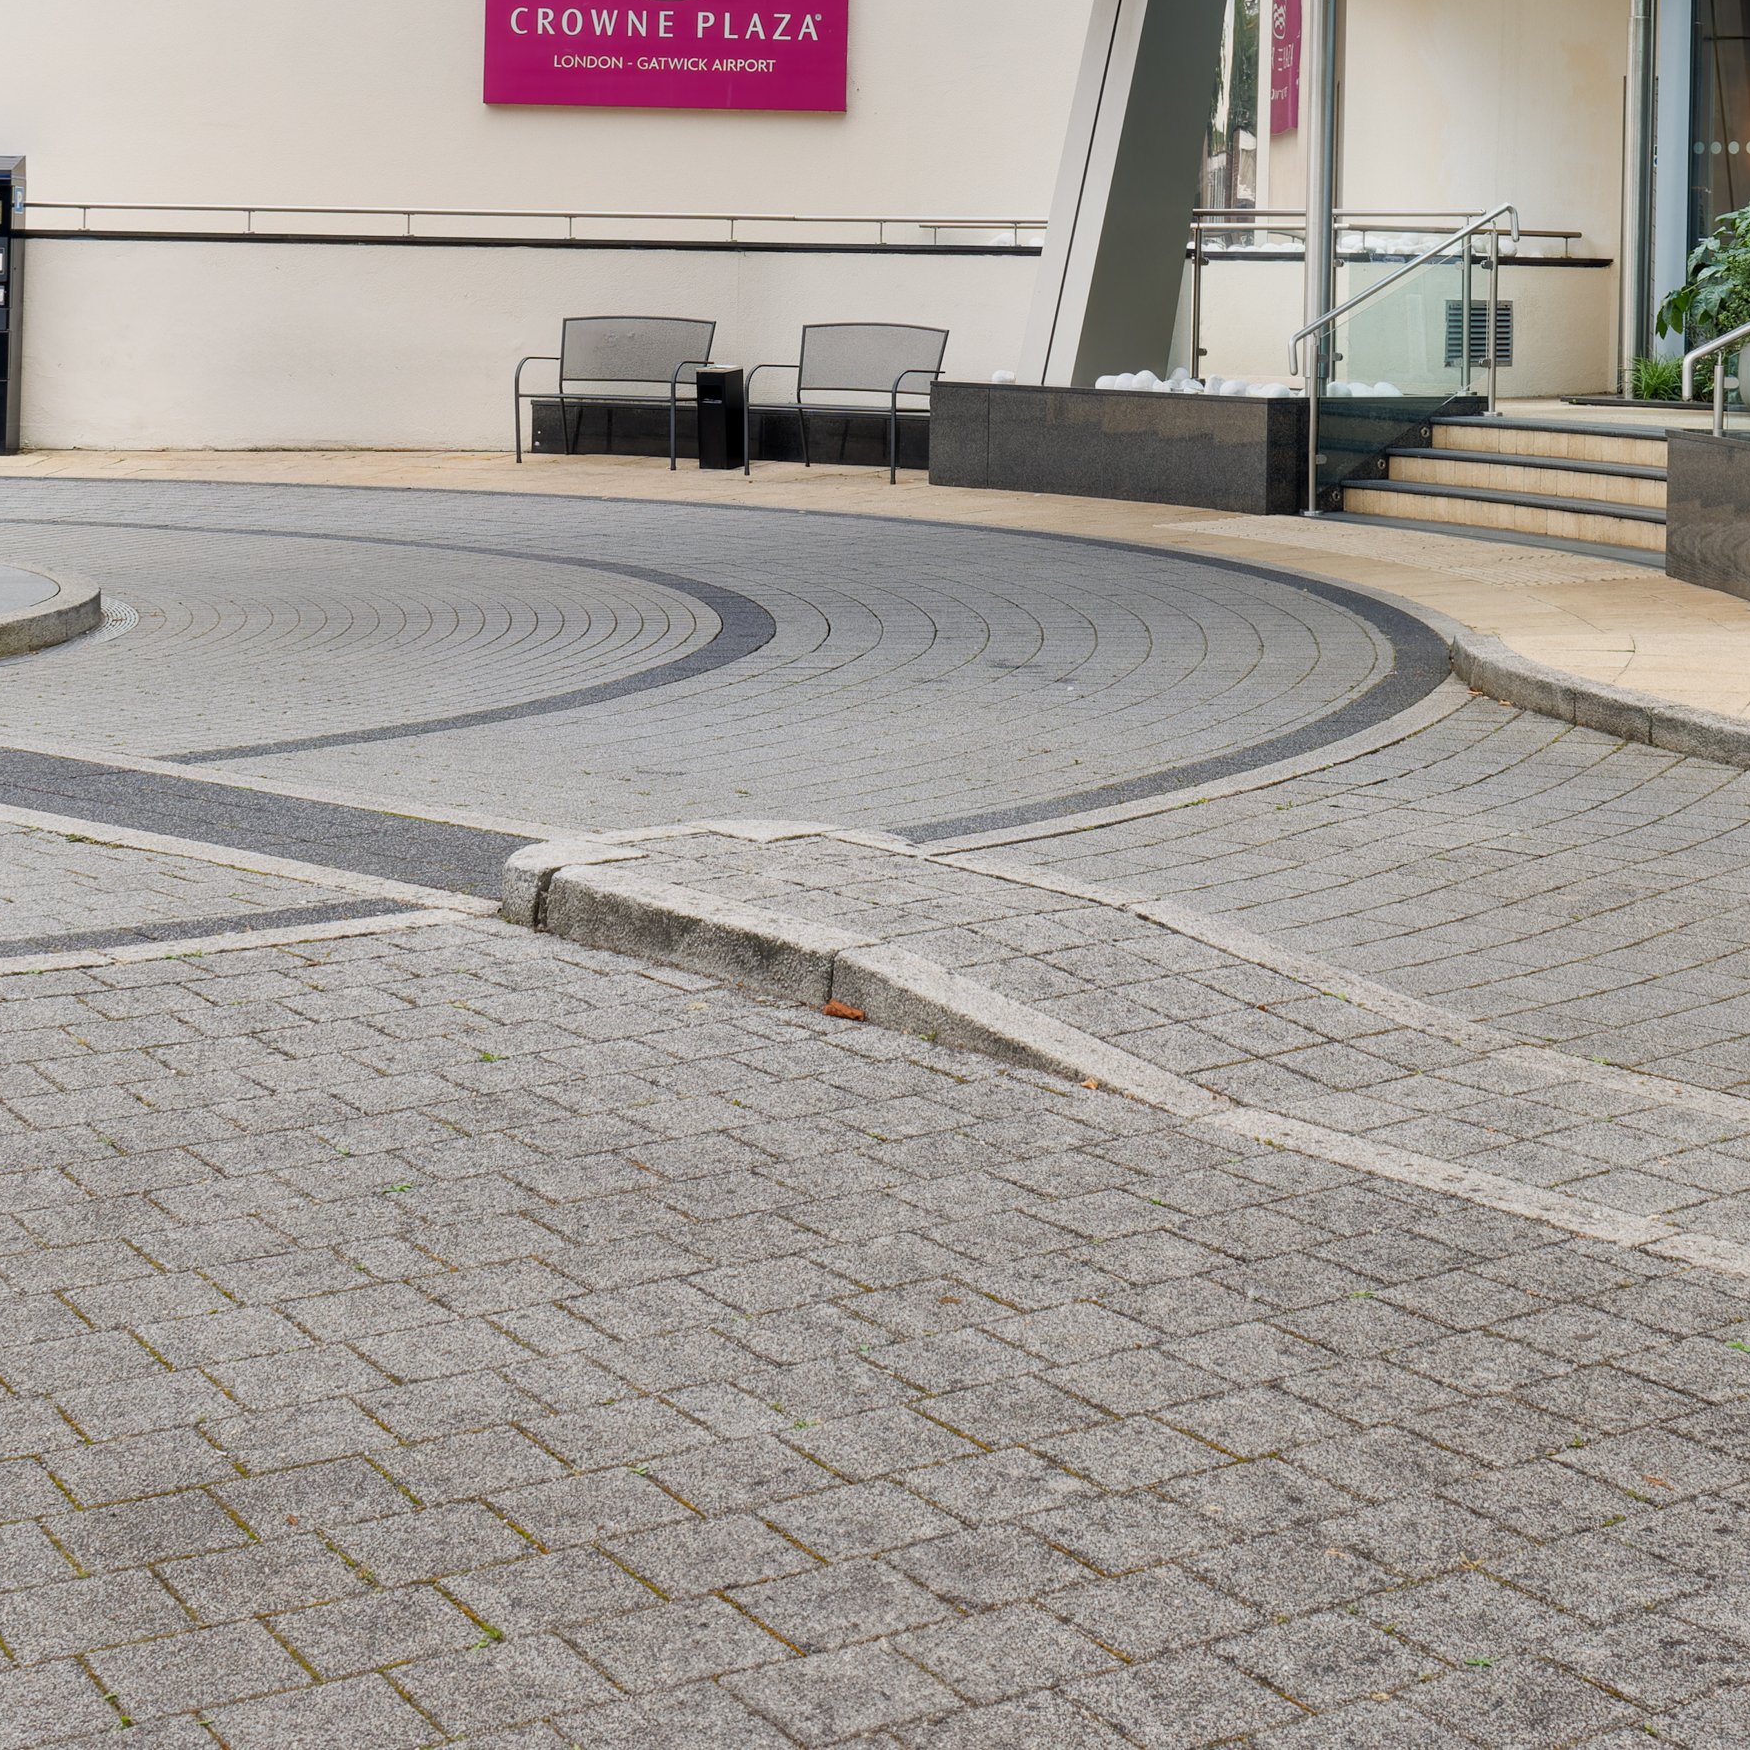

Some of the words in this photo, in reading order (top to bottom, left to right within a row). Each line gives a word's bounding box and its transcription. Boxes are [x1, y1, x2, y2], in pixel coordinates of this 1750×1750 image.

[509, 7, 674, 38] CROWNE
[553, 54, 624, 70] LONDON
[636, 56, 709, 72] GATWICK
[711, 58, 776, 72] AIRPORT
